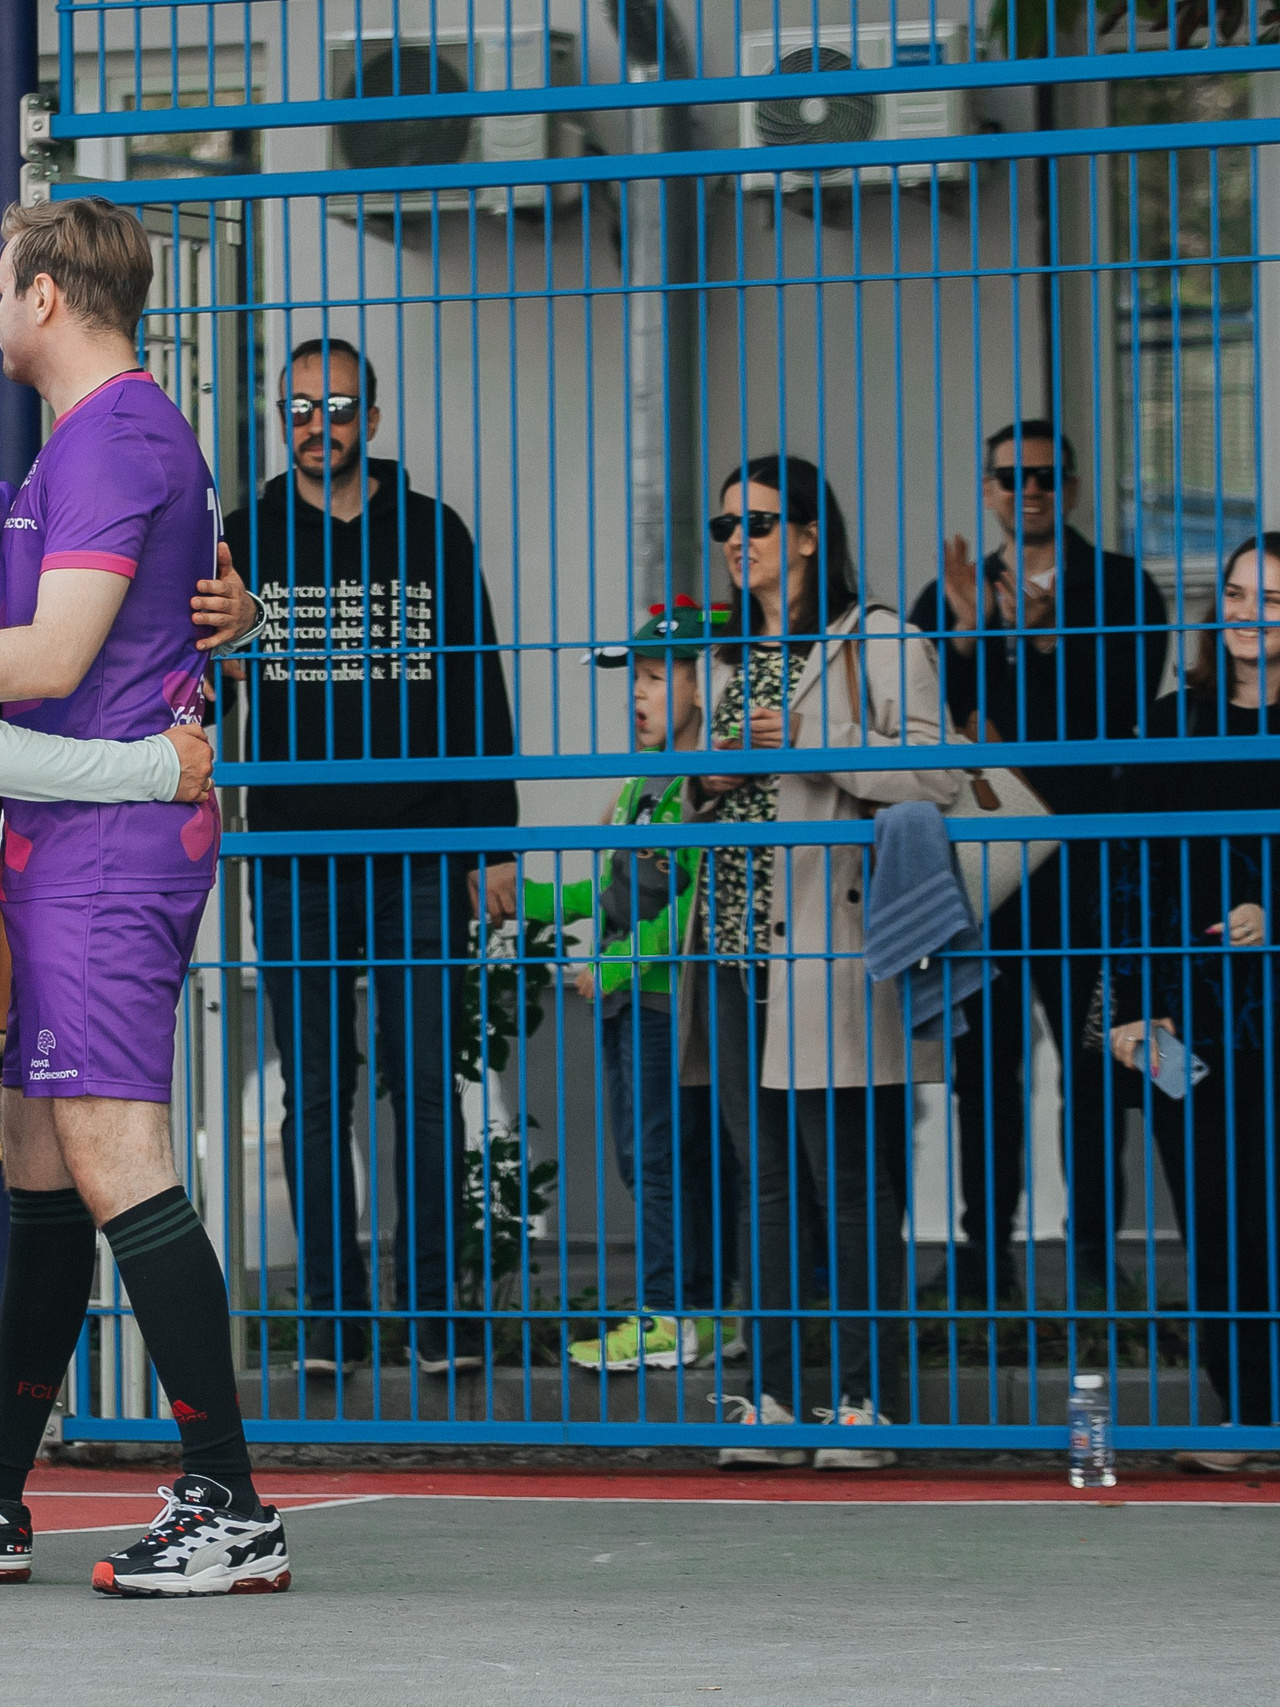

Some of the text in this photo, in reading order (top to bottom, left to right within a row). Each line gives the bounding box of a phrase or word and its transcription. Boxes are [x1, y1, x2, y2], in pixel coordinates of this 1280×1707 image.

[370, 583, 385, 596] &
[390, 579, 432, 599] Ftch
[370, 603, 385, 616] &
[390, 599, 432, 620] Ftch
[370, 624, 385, 637] &
[390, 620, 432, 640] Ftch
[371, 666, 386, 680] &
[390, 662, 432, 681] Ftch
